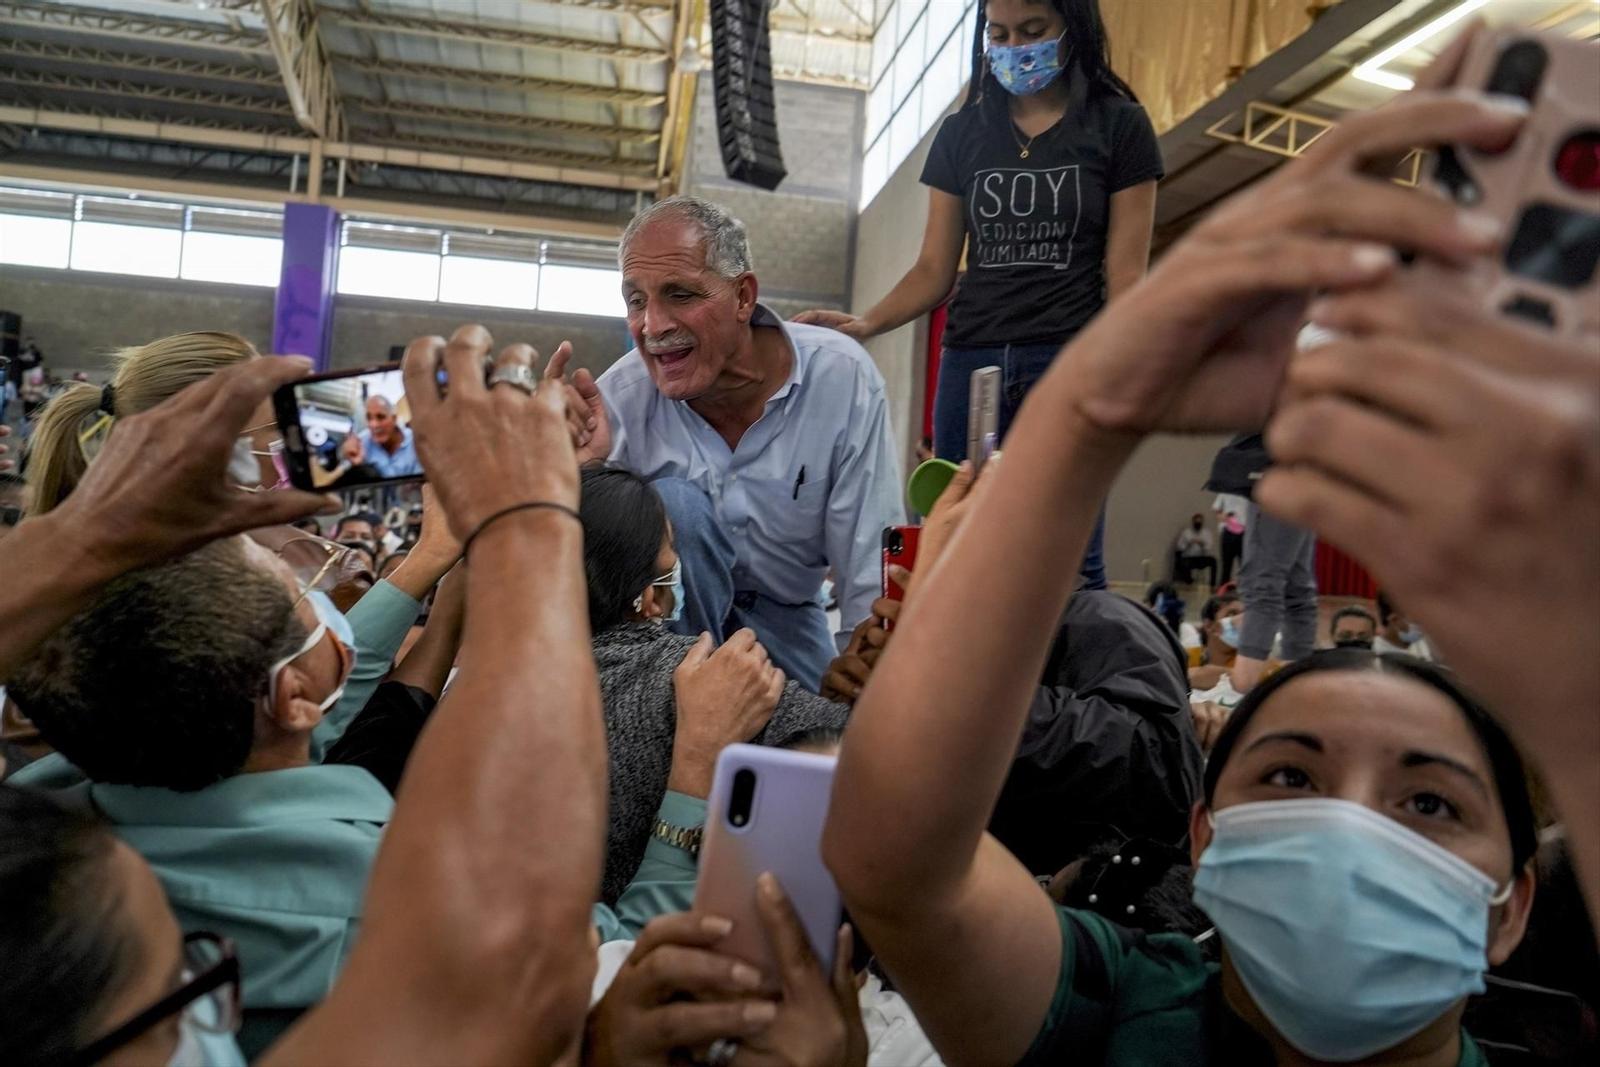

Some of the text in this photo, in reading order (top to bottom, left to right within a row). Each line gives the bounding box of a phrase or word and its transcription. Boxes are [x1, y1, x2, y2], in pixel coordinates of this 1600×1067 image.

[979, 171, 1067, 218] SOY
[981, 221, 1067, 241] EDICION
[983, 243, 1060, 263] LIMITADA
